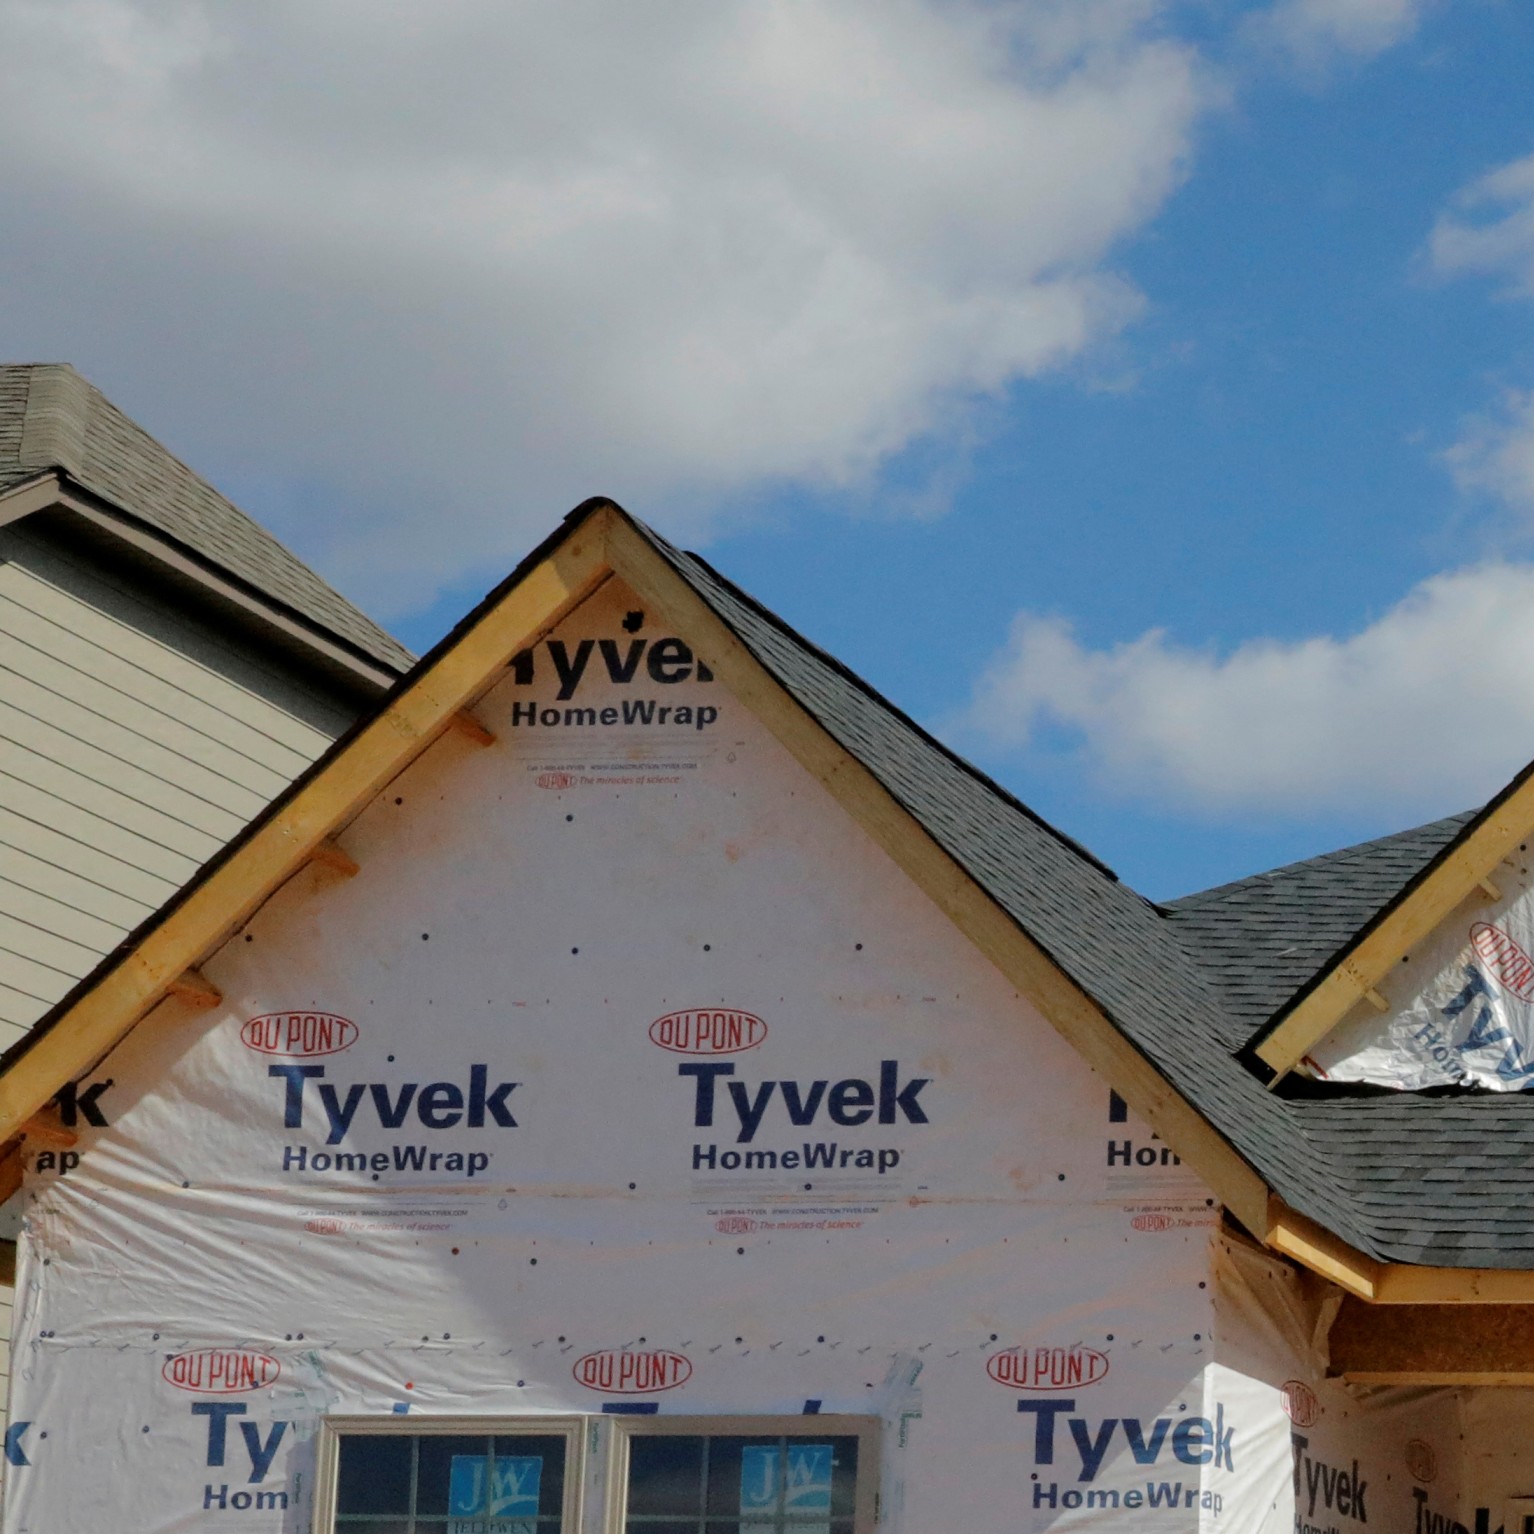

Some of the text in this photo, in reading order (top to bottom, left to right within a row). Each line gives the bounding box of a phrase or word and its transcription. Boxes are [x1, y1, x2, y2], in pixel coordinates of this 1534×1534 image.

[511, 700, 718, 730] HomeWrap
[268, 1064, 519, 1144] Tyvek
[678, 1060, 930, 1143] Tyvek
[282, 1145, 490, 1176] HomeWrap
[692, 1142, 900, 1173] HomeWrap
[1017, 1399, 1234, 1482] Tyvek
[1031, 1481, 1223, 1517] HomeWrap
[1291, 1433, 1368, 1524] Tyvek
